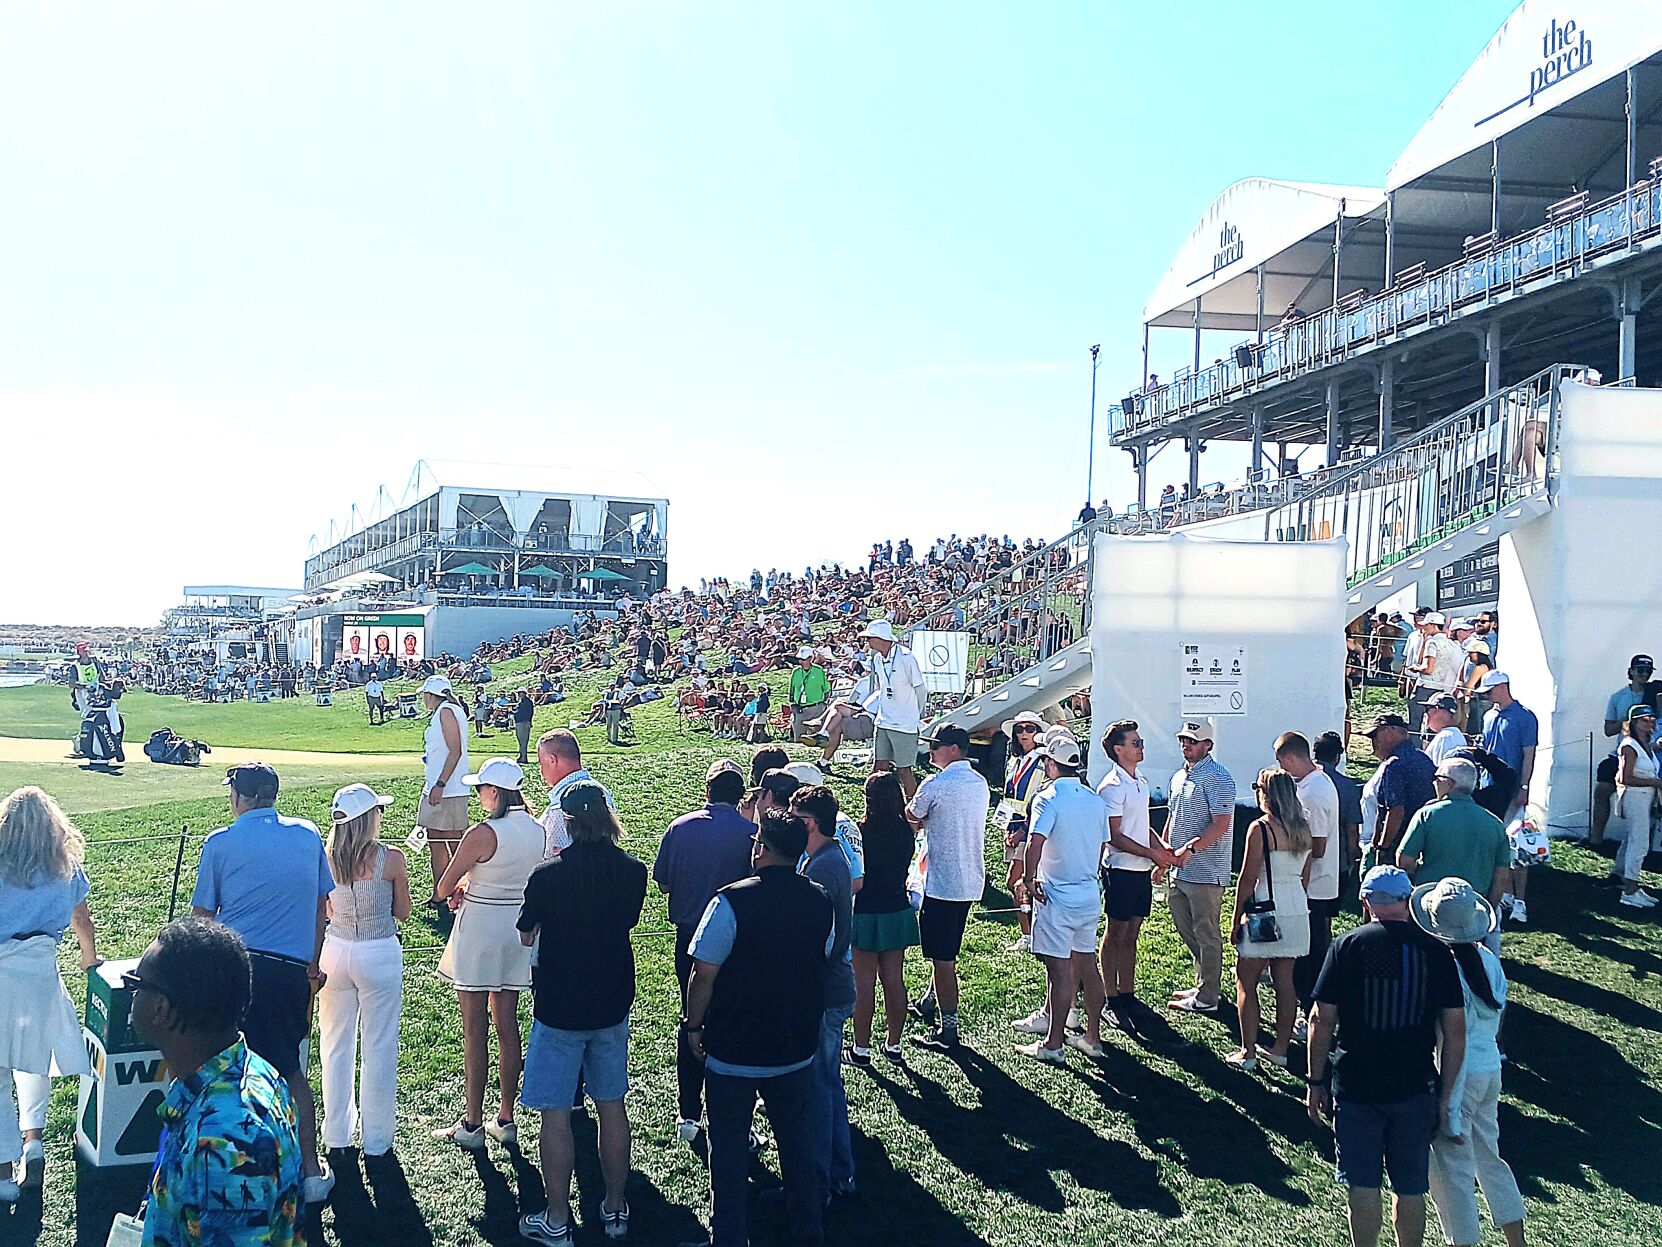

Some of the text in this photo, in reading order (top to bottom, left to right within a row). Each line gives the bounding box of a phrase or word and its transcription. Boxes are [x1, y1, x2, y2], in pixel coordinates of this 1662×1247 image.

[1542, 18, 1576, 59] the
[1528, 29, 1593, 108] perch
[1212, 232, 1244, 280] perch
[1220, 221, 1237, 248] the
